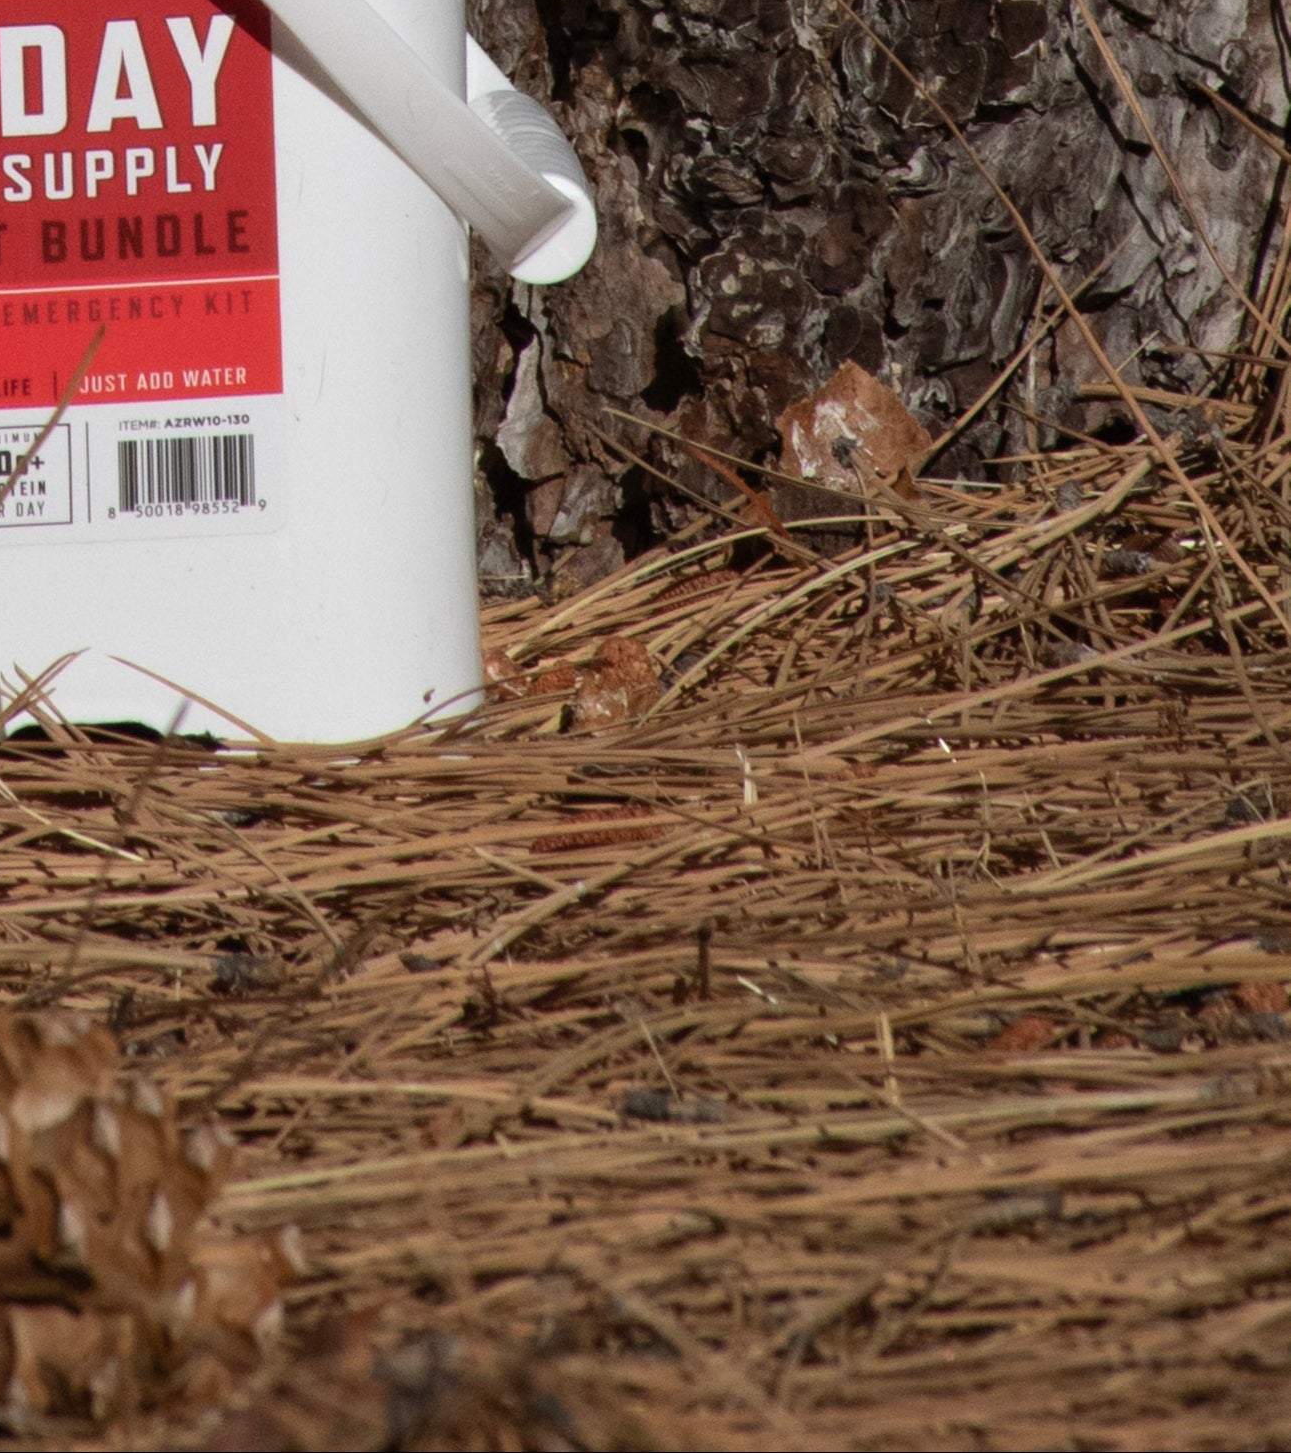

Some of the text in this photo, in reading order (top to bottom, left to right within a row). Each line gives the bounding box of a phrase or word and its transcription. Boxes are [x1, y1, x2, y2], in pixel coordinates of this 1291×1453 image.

[0, 14, 235, 136] DAY
[3, 144, 222, 201] SUPPLY
[41, 210, 249, 264] BUNDLE
[3, 295, 182, 330] EMERGENCY
[205, 289, 251, 315] KIT
[79, 367, 246, 393] JUST ADD WATER
[164, 414, 250, 428] AZRW10-130
[16, 502, 45, 517] DAY
[136, 502, 239, 518] 50018 98552
